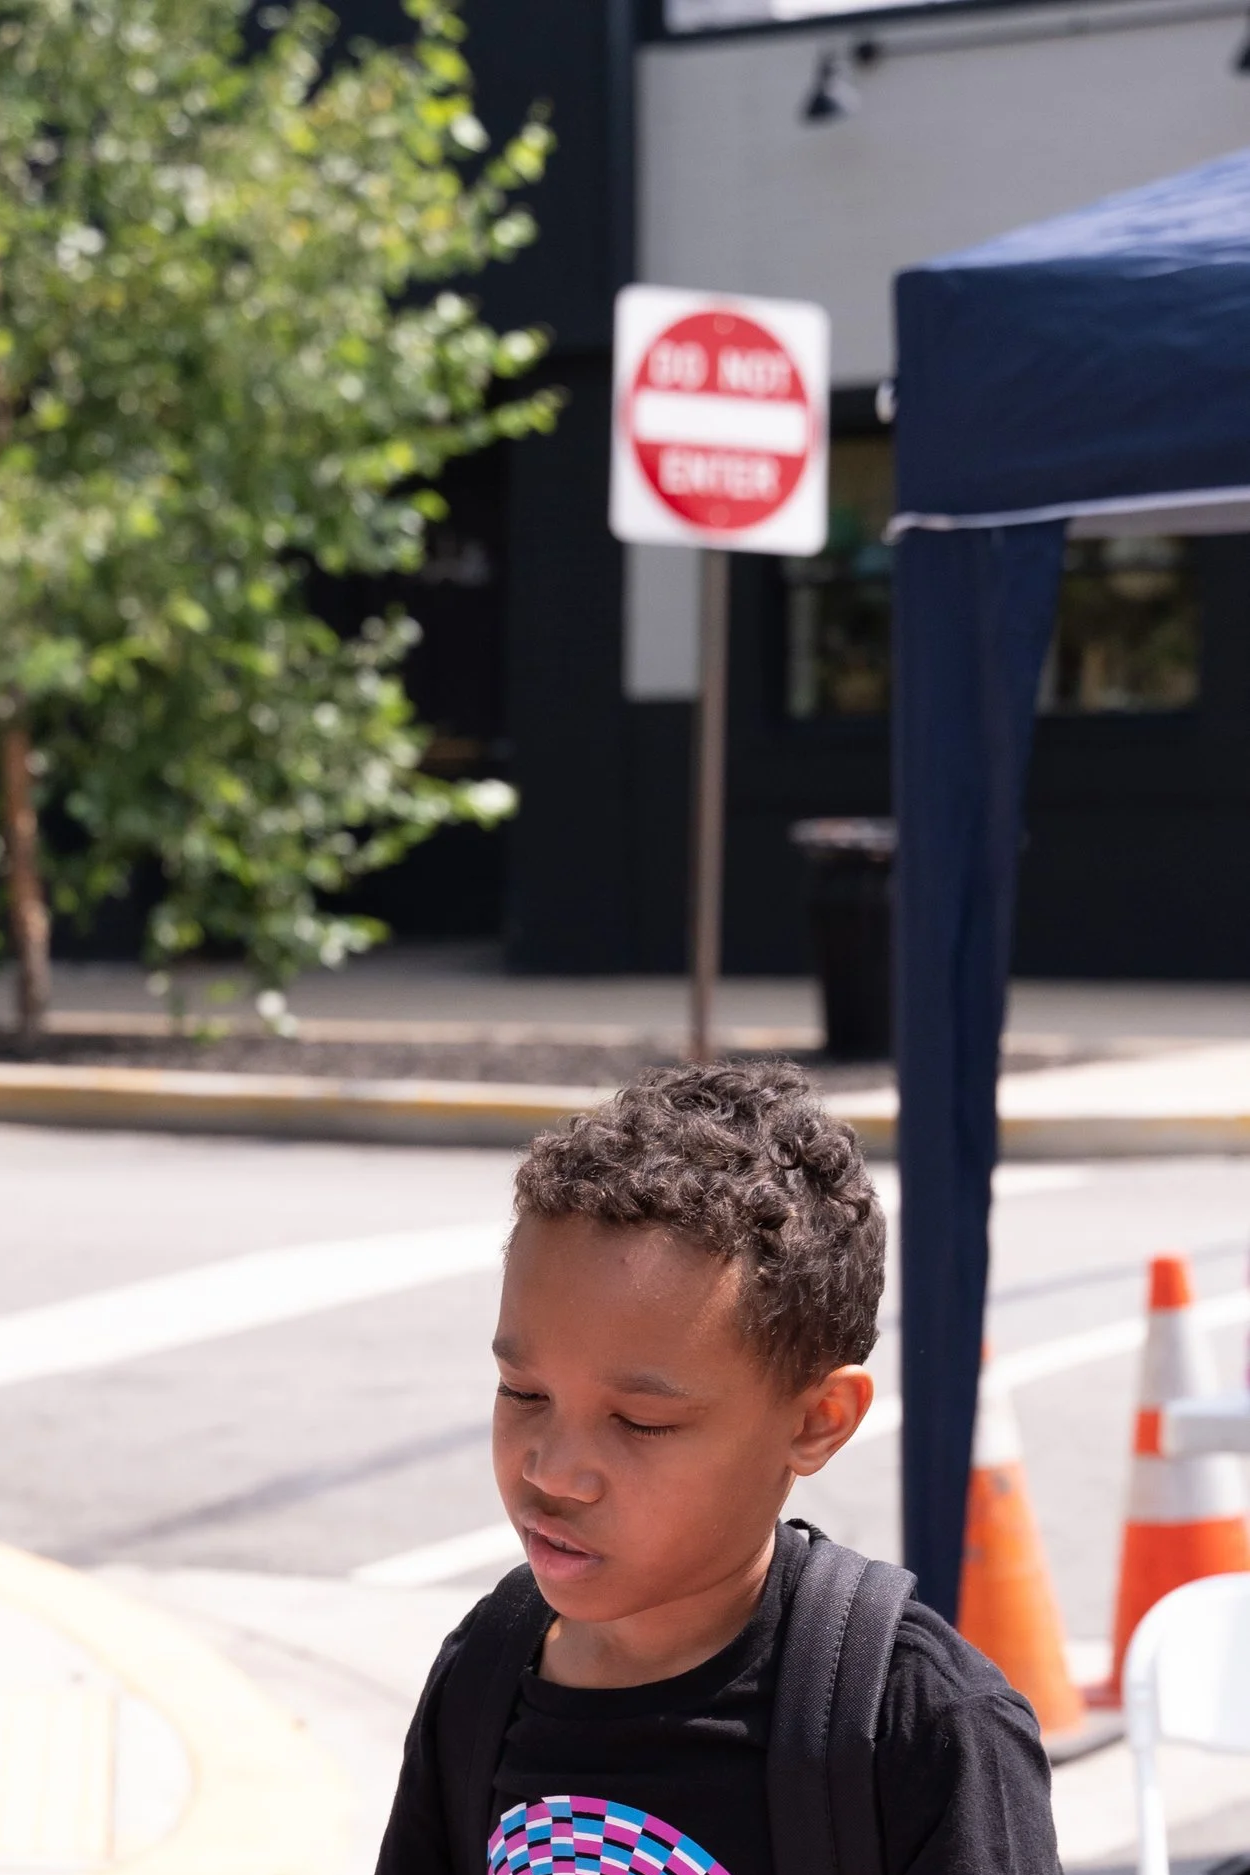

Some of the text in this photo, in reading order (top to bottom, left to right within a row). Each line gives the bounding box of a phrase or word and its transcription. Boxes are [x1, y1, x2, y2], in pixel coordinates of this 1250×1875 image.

[647, 338, 792, 398] DO NOT
[657, 446, 781, 503] ENTER
